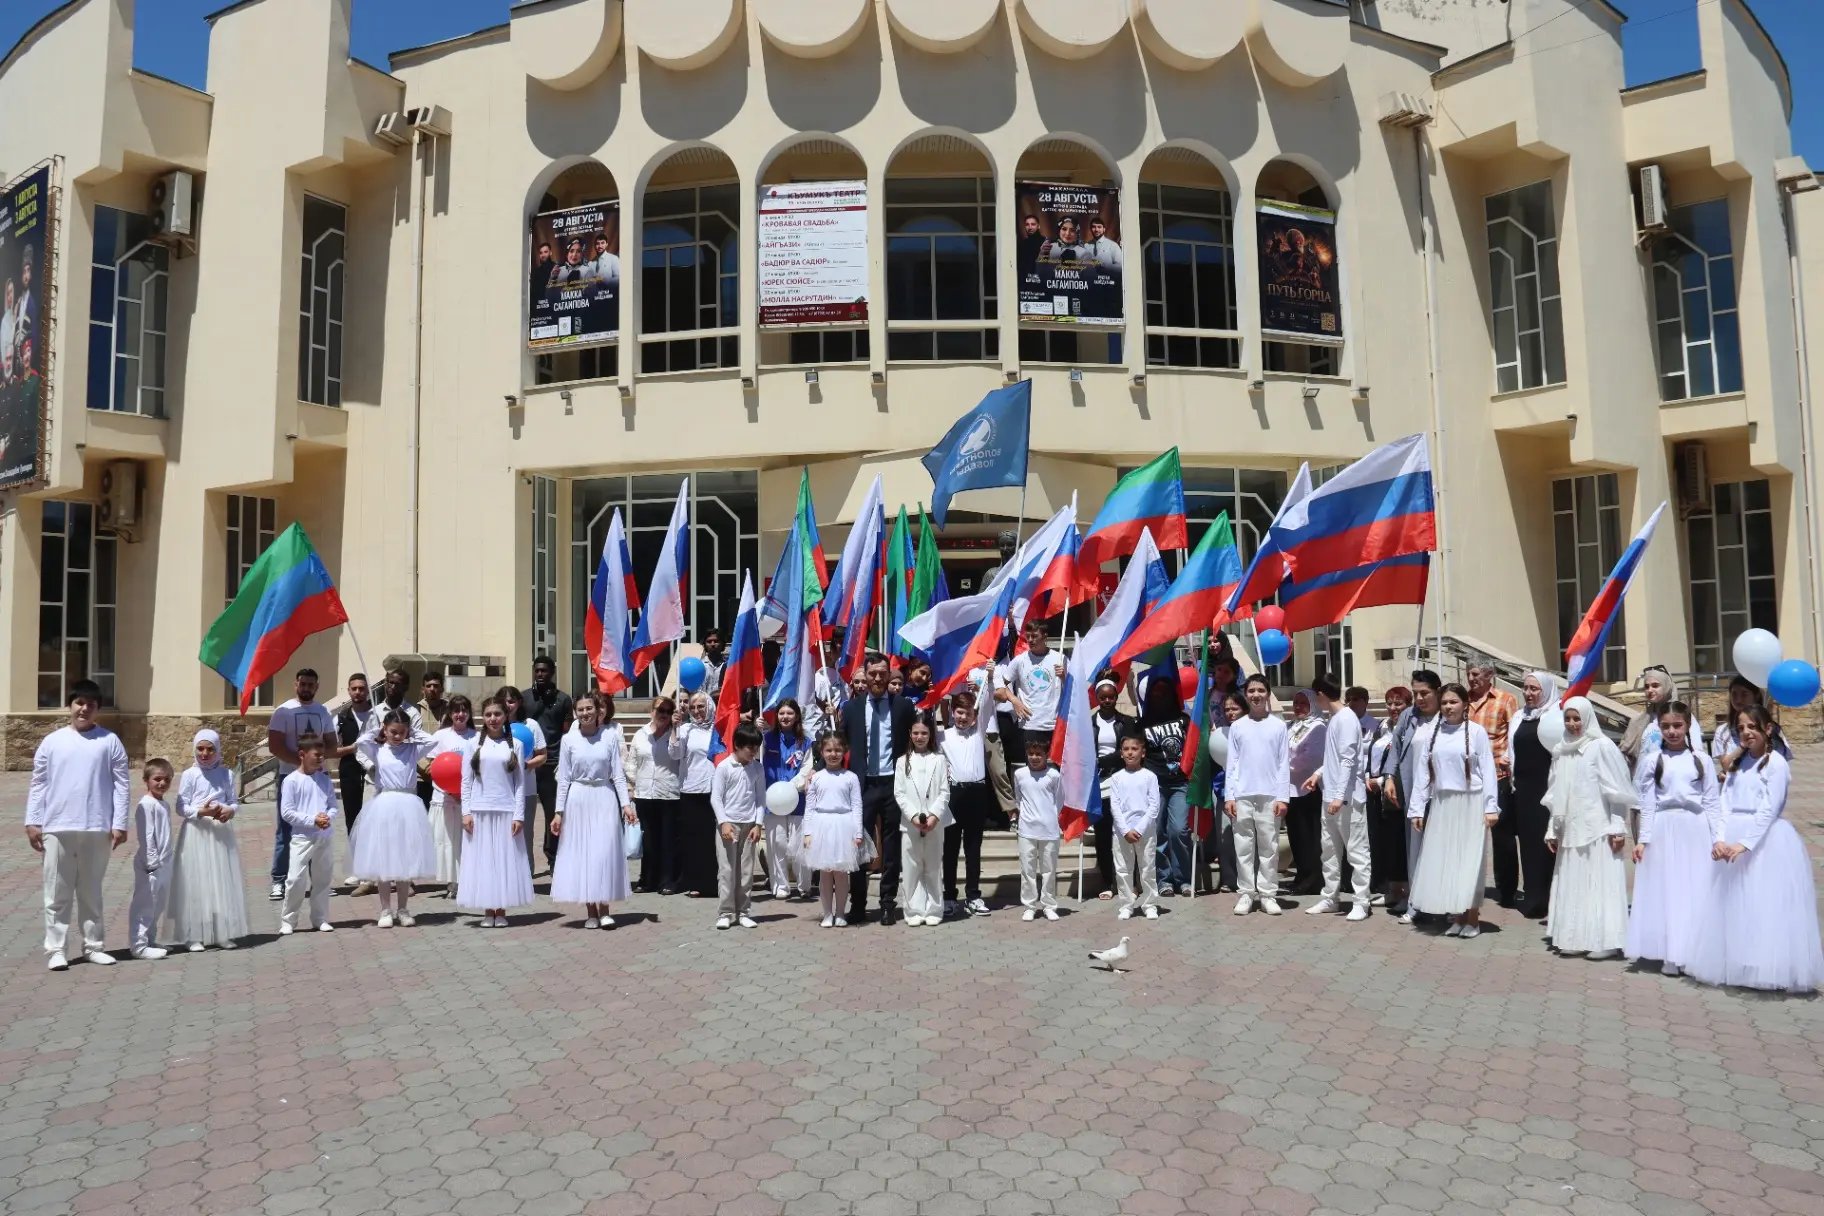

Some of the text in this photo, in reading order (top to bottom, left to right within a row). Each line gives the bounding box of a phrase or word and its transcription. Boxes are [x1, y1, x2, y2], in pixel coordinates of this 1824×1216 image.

[1038, 191, 1099, 204] 28 АВГУСТА
[552, 218, 564, 229] 28
[565, 212, 604, 227] АВГУСТА
[1054, 269, 1080, 280] МАККА
[1046, 280, 1089, 290] САГАИПОВА
[560, 289, 583, 301] МАККА
[1267, 283, 1332, 303] ПУТЬ ГОРЦА
[553, 299, 590, 312] САГАИПОВА
